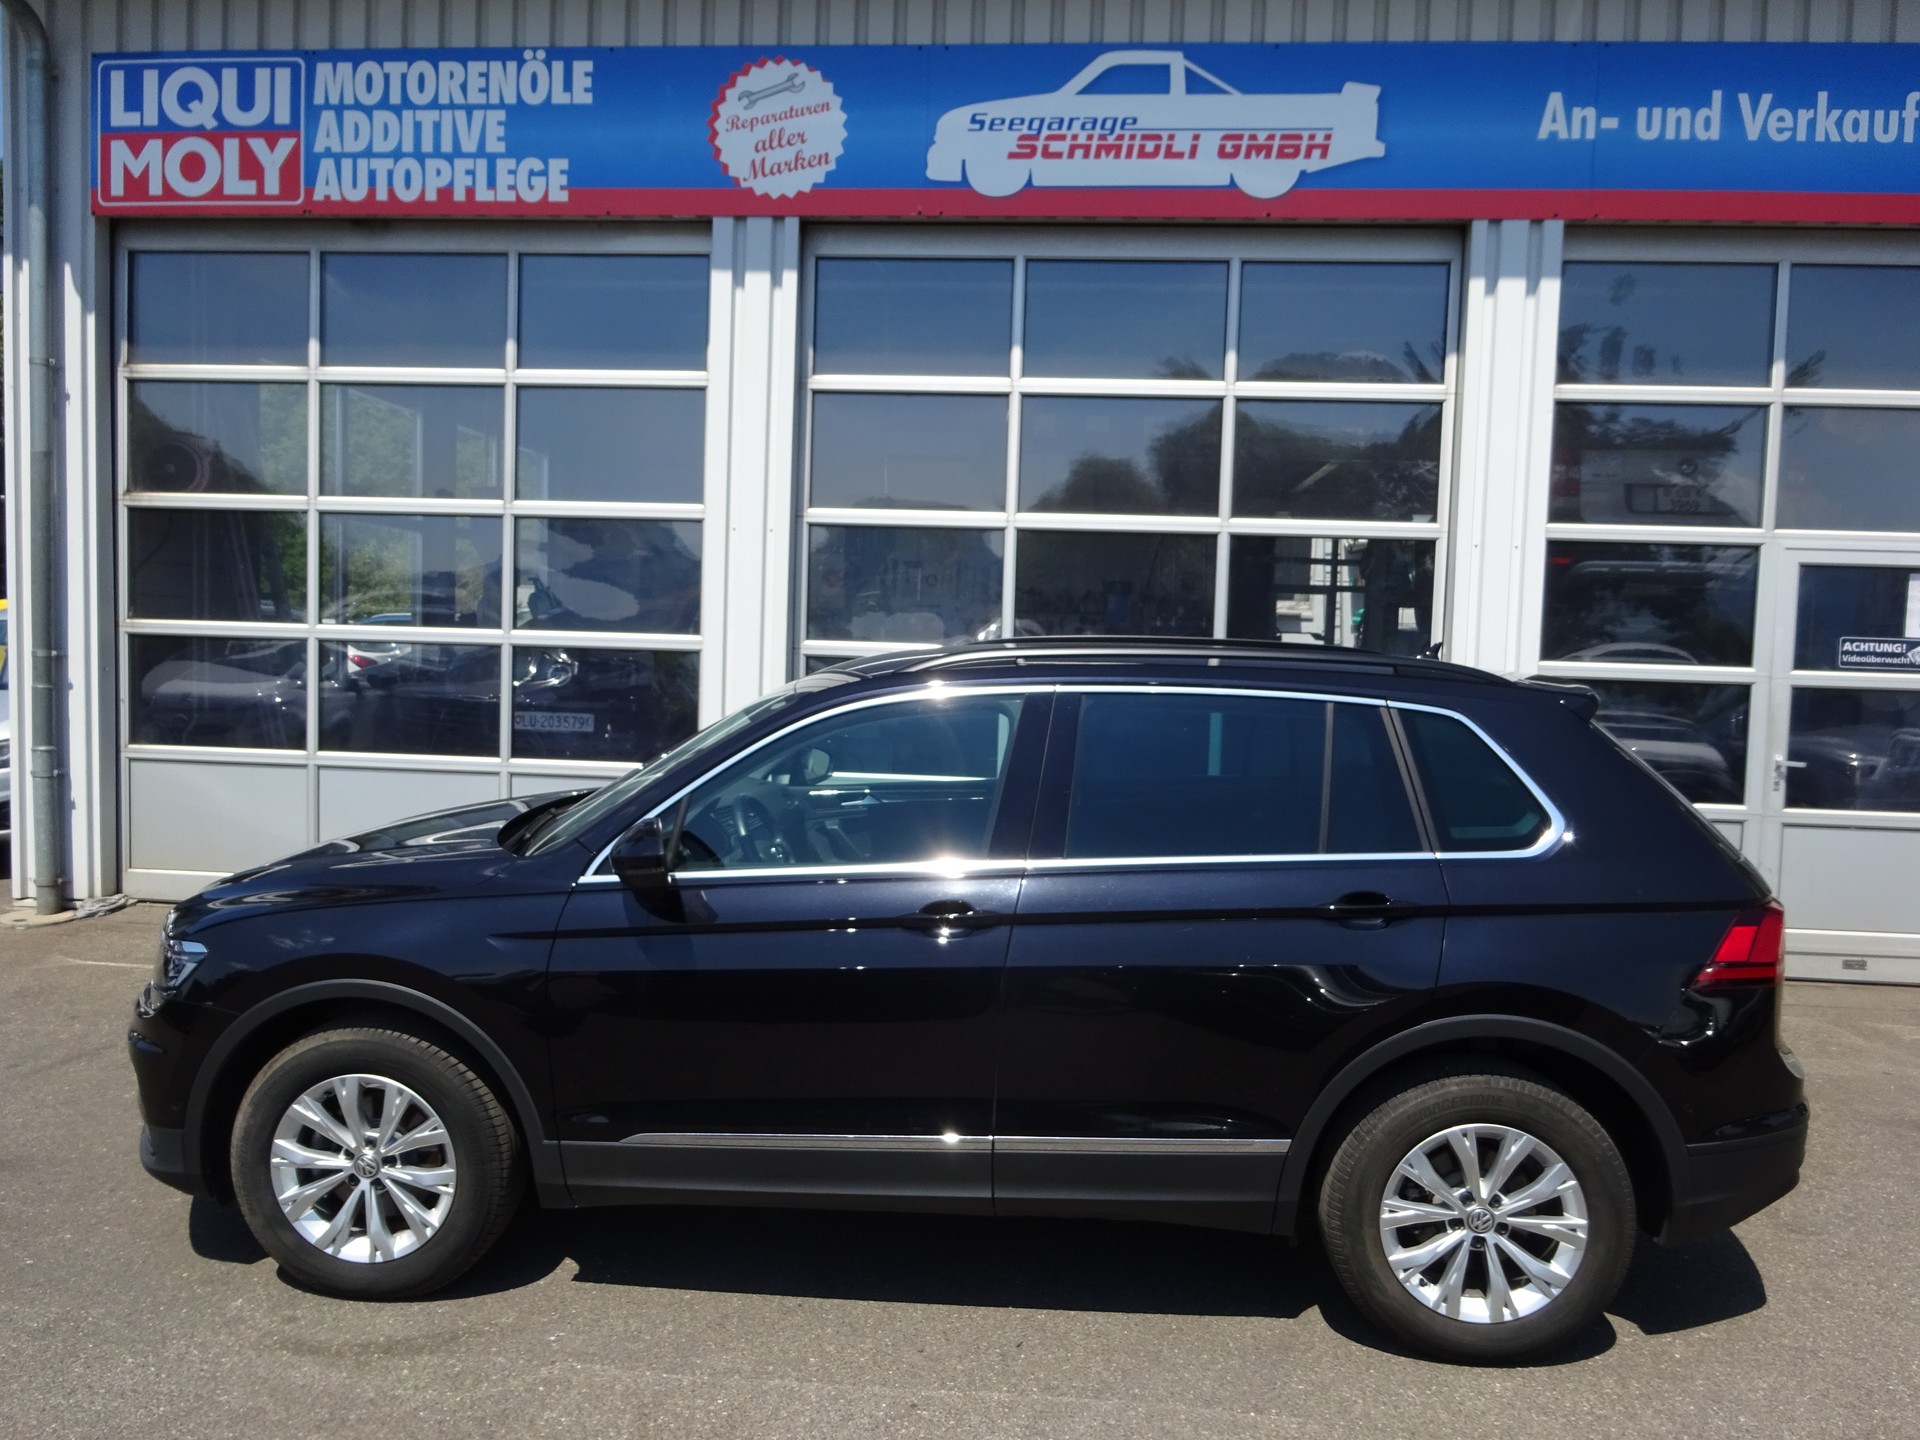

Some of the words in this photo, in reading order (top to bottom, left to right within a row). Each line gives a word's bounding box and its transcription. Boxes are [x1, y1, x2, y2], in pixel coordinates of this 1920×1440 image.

[313, 49, 594, 106] MOTORENÖLE
[109, 66, 291, 130] LIQUI
[725, 101, 831, 132] Reparaturen
[1537, 91, 1619, 140] An-
[1636, 90, 1723, 141] und
[1738, 91, 1920, 144] Verkauf
[313, 109, 507, 154] ADDITIVE
[754, 126, 808, 154] aller
[967, 112, 1138, 137] Seegarage
[742, 149, 831, 182] Marken
[1007, 133, 1201, 160] SCHMIDLI
[1217, 133, 1333, 160] GMBH
[109, 136, 298, 198] MOLY
[312, 158, 569, 203] AUTOPFLEGE
[1842, 641, 1907, 653] ACHTUNG!
